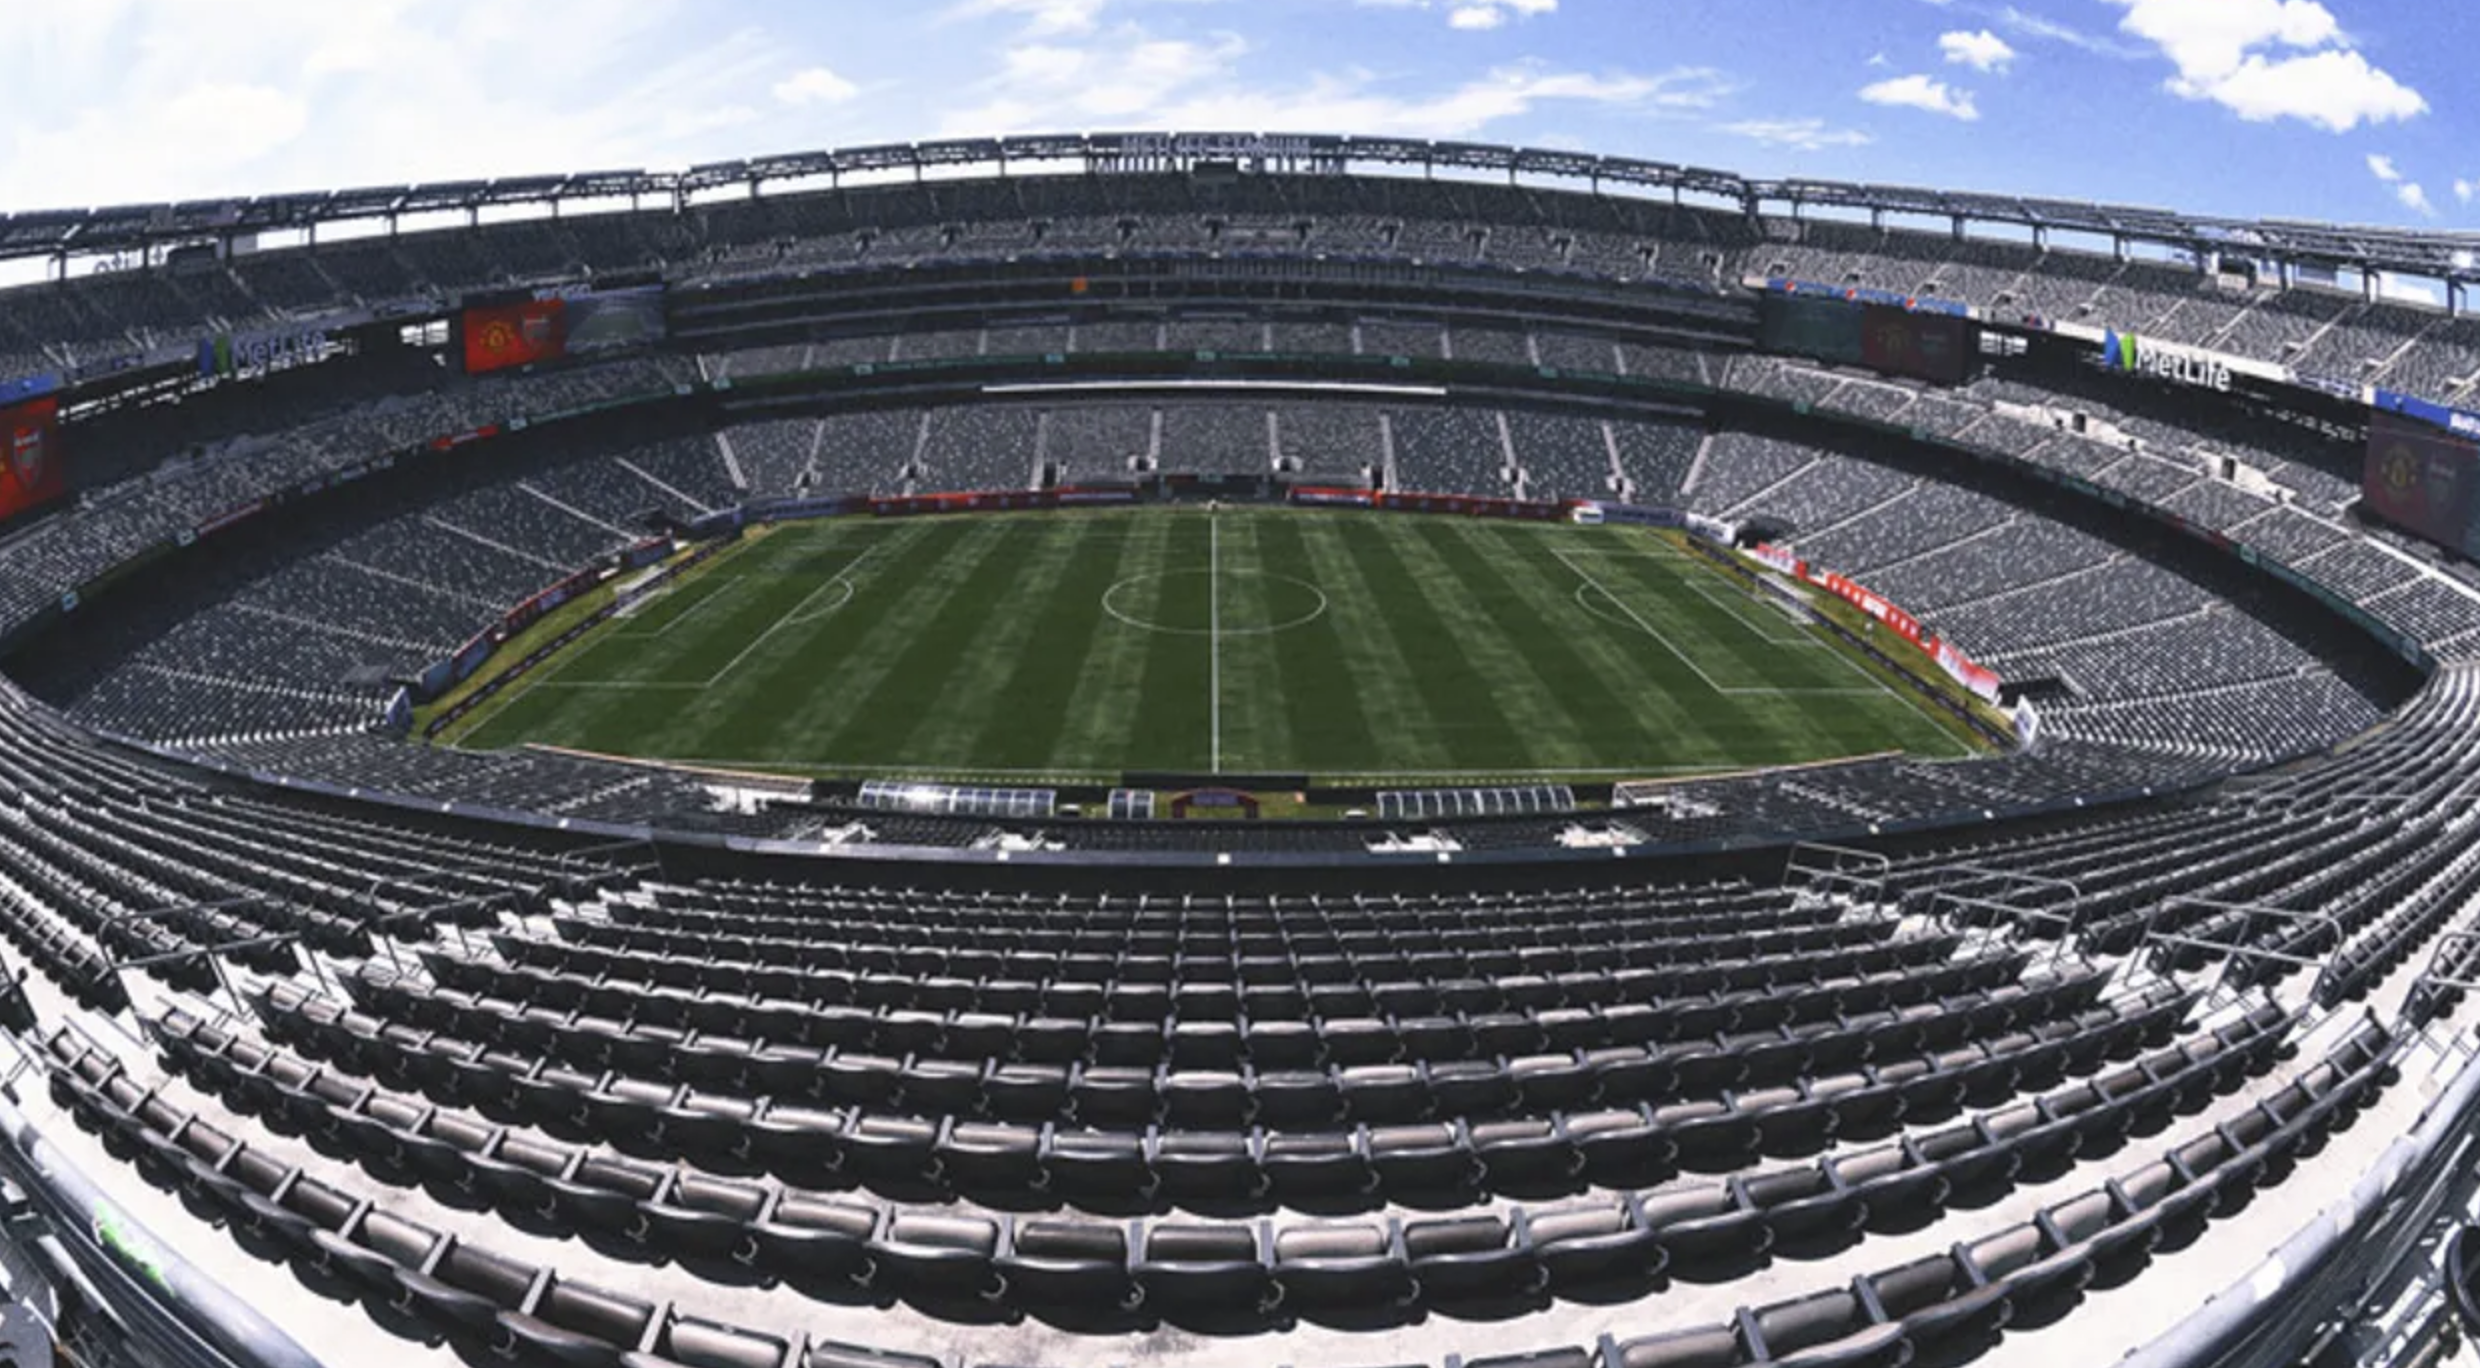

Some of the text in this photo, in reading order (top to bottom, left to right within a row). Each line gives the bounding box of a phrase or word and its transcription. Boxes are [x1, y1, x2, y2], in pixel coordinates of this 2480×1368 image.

[1218, 134, 1310, 158] STADIUM
[233, 331, 326, 366] MetLife
[2137, 344, 2231, 391] MetLife
